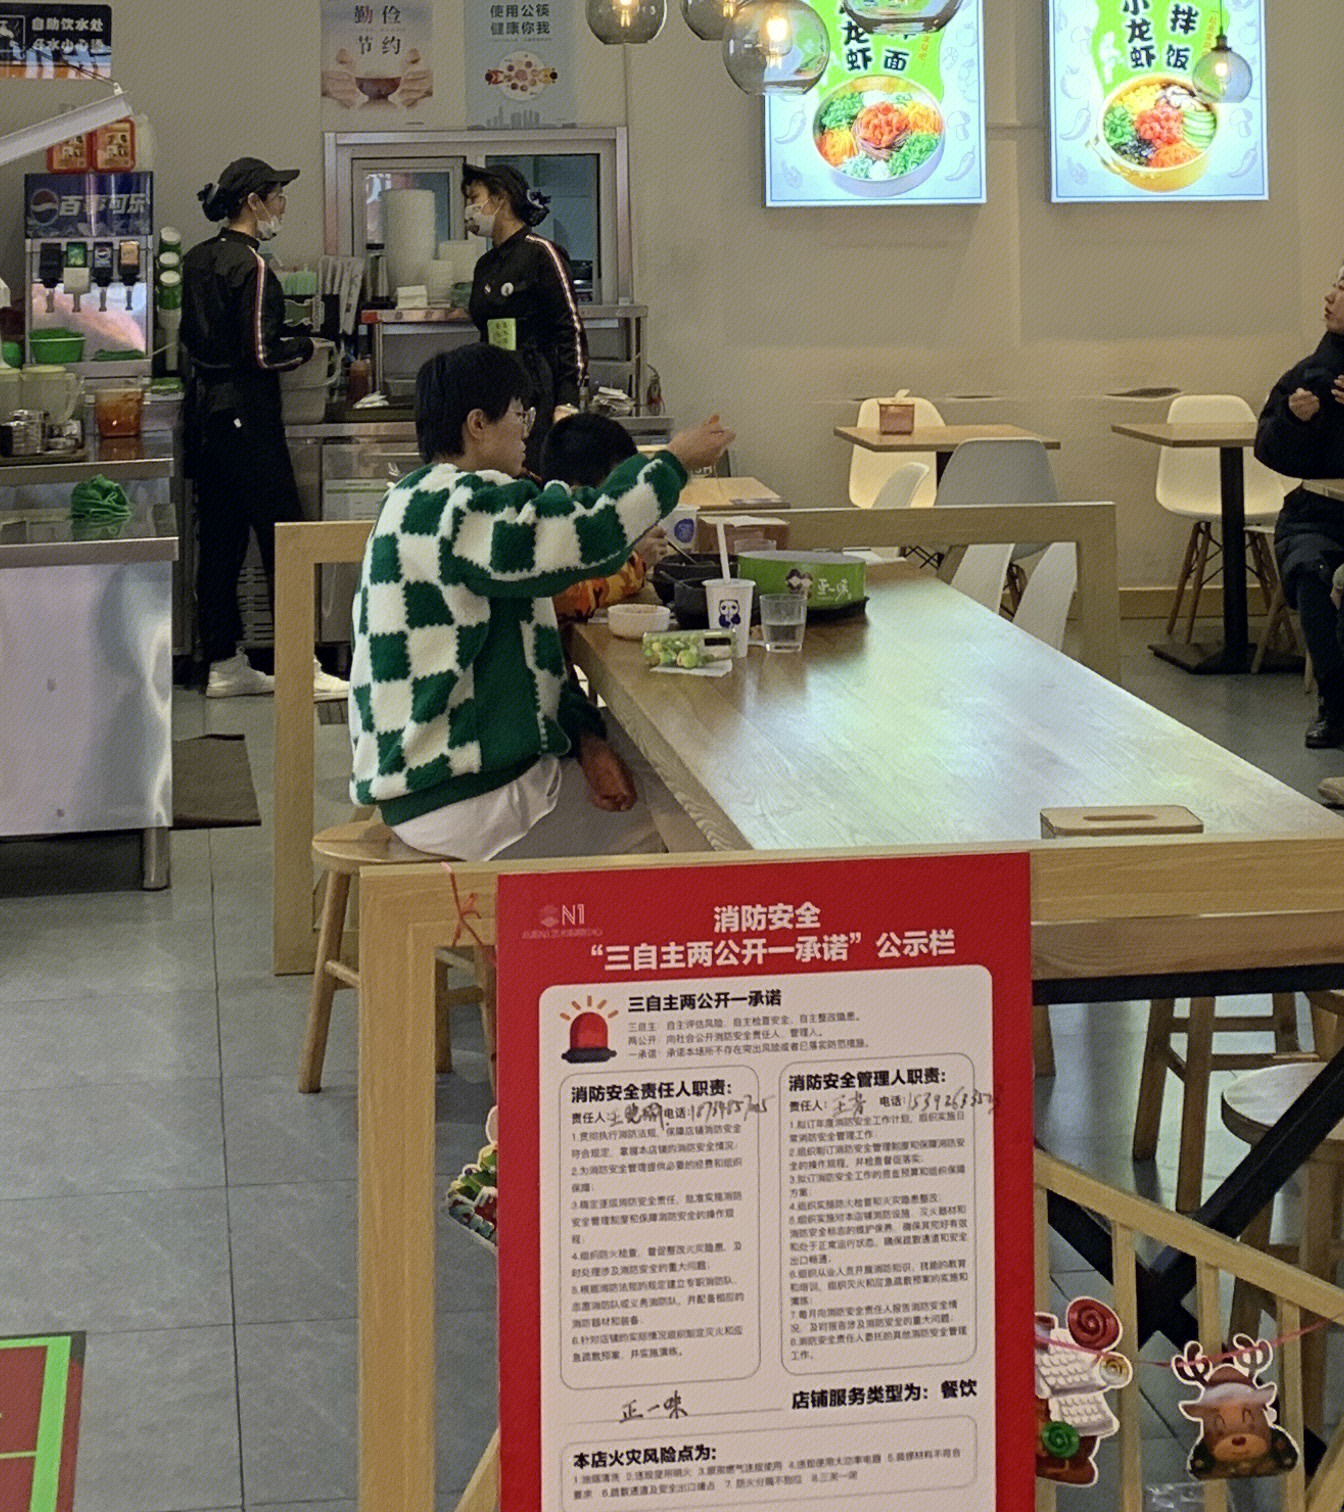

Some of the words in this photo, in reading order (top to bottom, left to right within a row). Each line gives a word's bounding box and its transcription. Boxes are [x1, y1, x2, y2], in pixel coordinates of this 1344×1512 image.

[354, 5, 402, 25] 勤俭
[489, 3, 551, 19] 使用公筷
[31, 17, 104, 32] 自助饮水处
[490, 21, 551, 36] 健康你我
[1165, 3, 1199, 71] 拌饭
[358, 36, 402, 56] 节约
[561, 903, 586, 926] N1
[713, 900, 822, 934] 消防安全
[627, 988, 782, 1013] 三自主两公开一承诺
[570, 1078, 733, 1104] 消防安全责任人职责：
[788, 1066, 947, 1092] 消防安全管理人职责：
[618, 1389, 689, 1424] 正一味
[573, 1443, 717, 1470] 本店火灾风险点为：
